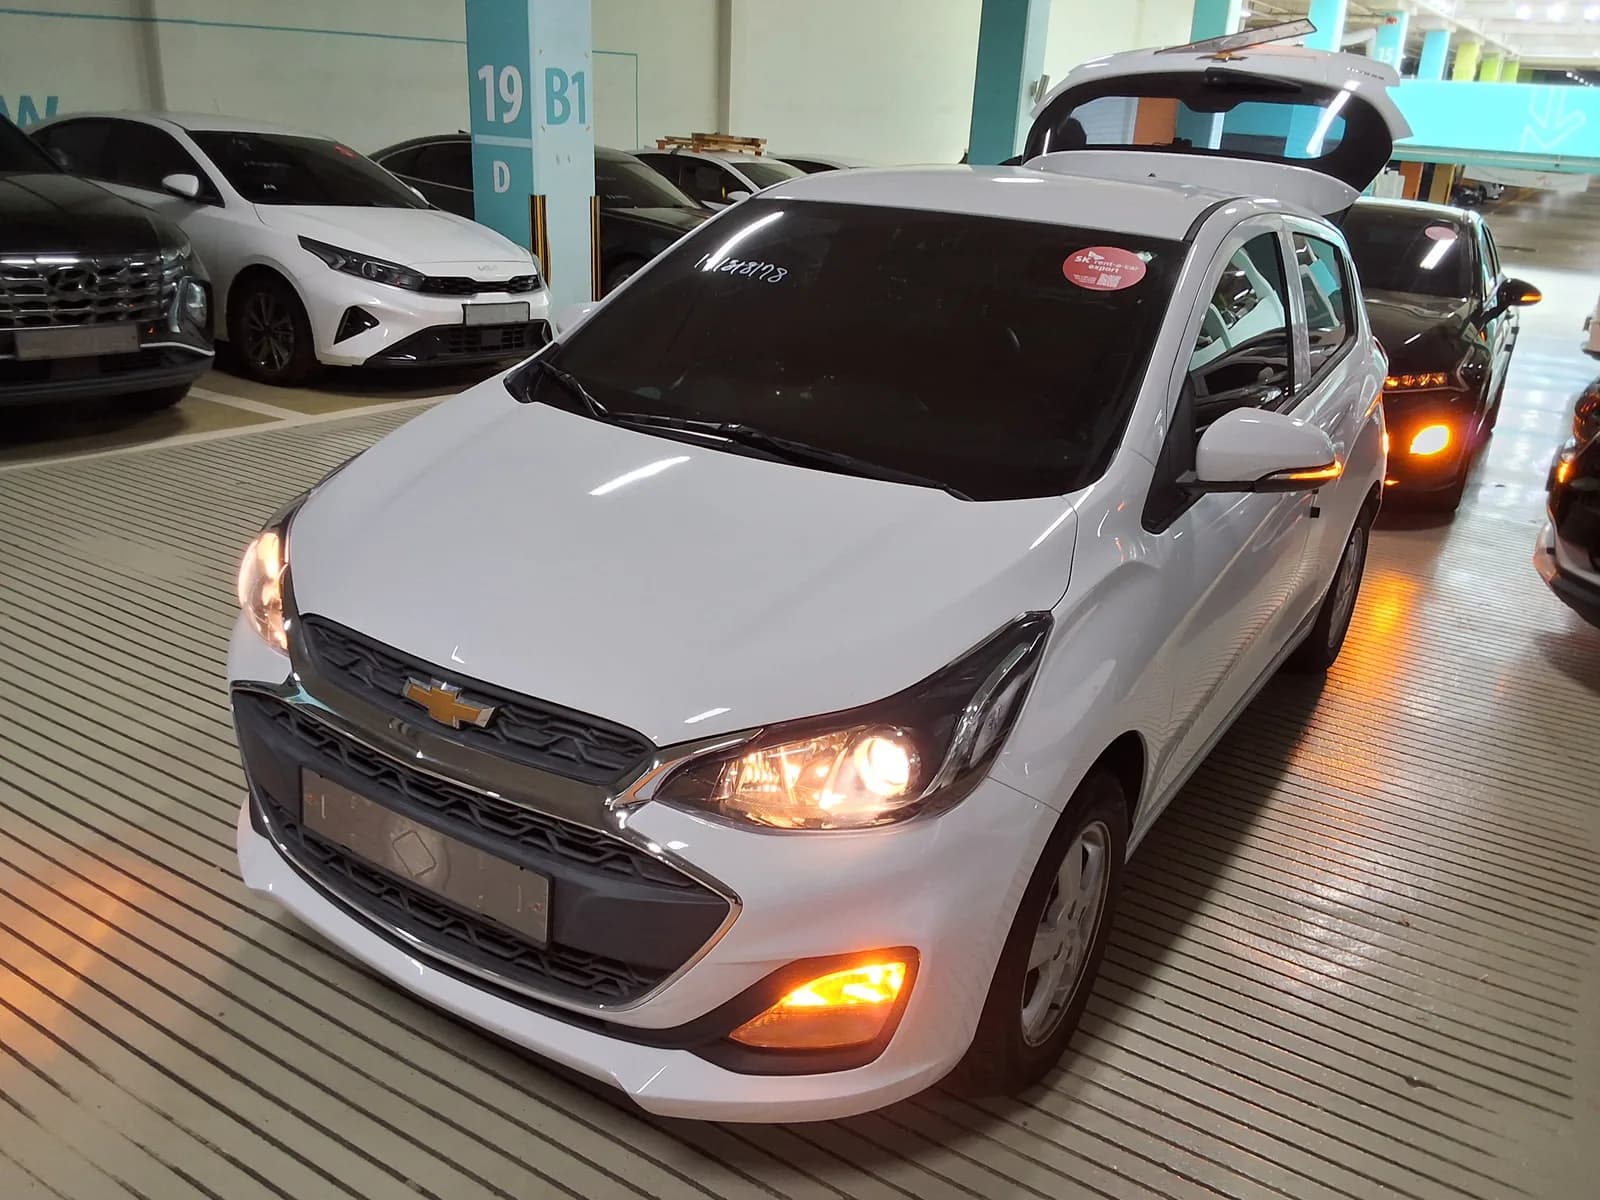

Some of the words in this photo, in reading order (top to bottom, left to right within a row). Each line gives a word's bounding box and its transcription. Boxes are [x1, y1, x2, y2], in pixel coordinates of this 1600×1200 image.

[477, 64, 523, 124] 19
[544, 67, 586, 125] B1
[492, 160, 511, 193] D
[1075, 255, 1091, 264] SK
[1088, 264, 1120, 273] export
